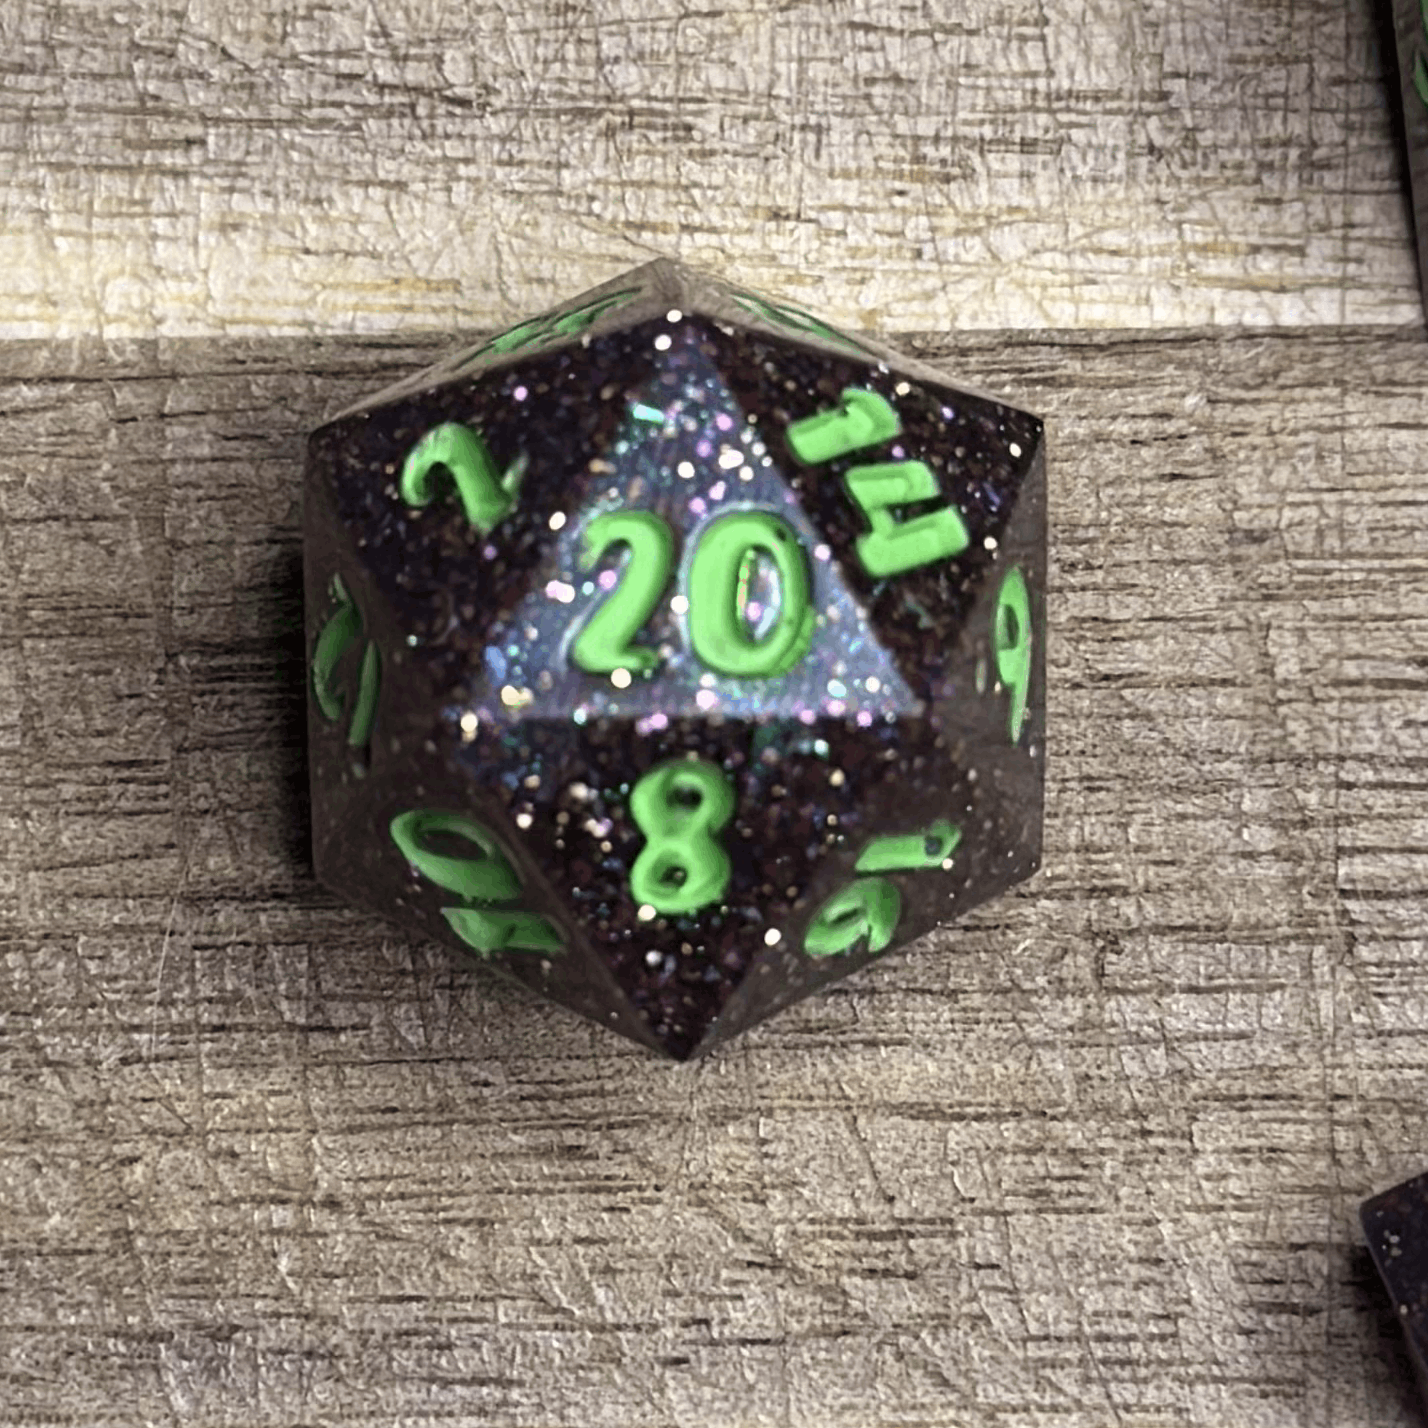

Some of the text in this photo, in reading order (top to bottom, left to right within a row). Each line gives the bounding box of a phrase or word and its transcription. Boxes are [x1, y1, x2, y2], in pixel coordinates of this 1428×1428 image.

[401, 422, 529, 537] 2
[786, 387, 969, 578] 14
[571, 508, 815, 681] 20
[390, 809, 568, 960] 10
[629, 759, 736, 915] 8
